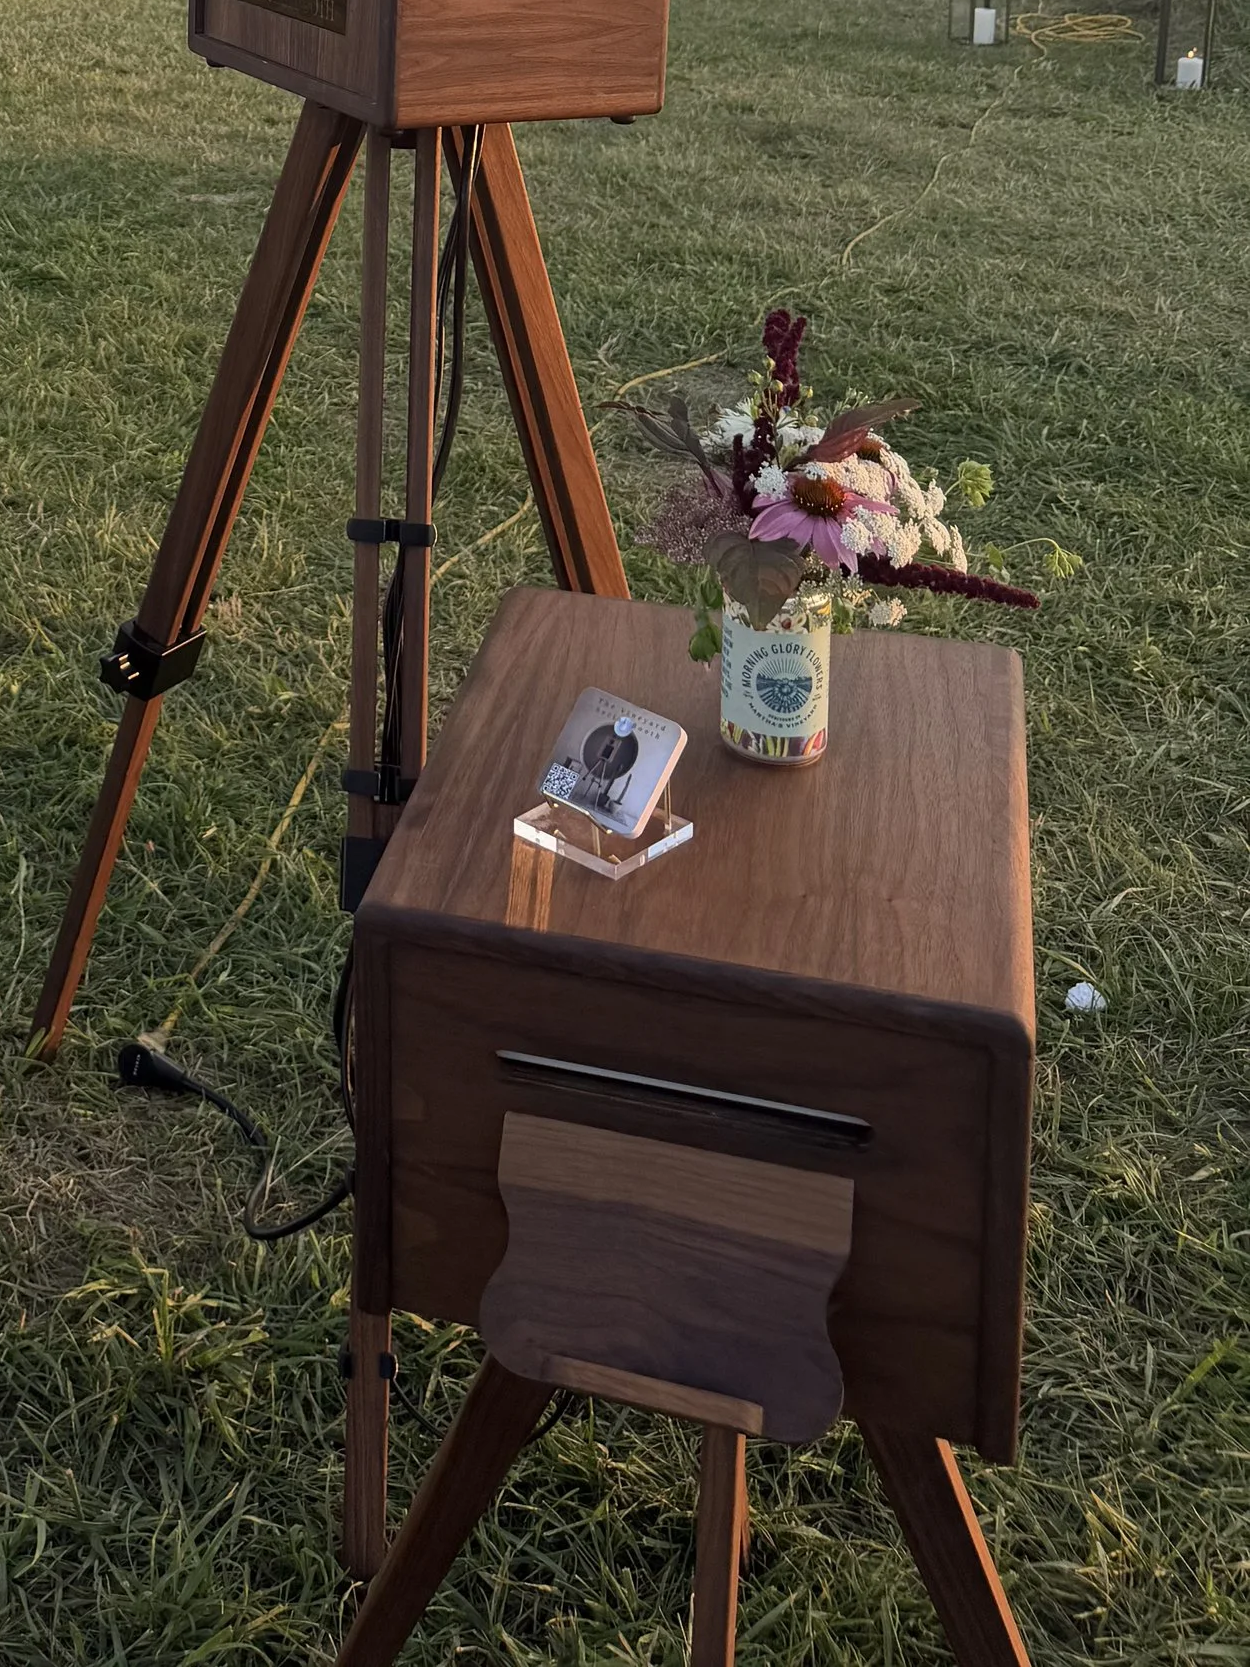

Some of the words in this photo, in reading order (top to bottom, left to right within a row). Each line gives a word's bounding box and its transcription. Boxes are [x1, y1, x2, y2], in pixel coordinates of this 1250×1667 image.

[741, 646, 769, 688] MORNING
[771, 642, 807, 656] GLORY
[806, 649, 825, 690] FLOWERS
[620, 706, 667, 732] Vineyard
[785, 703, 818, 728] VINEYARD
